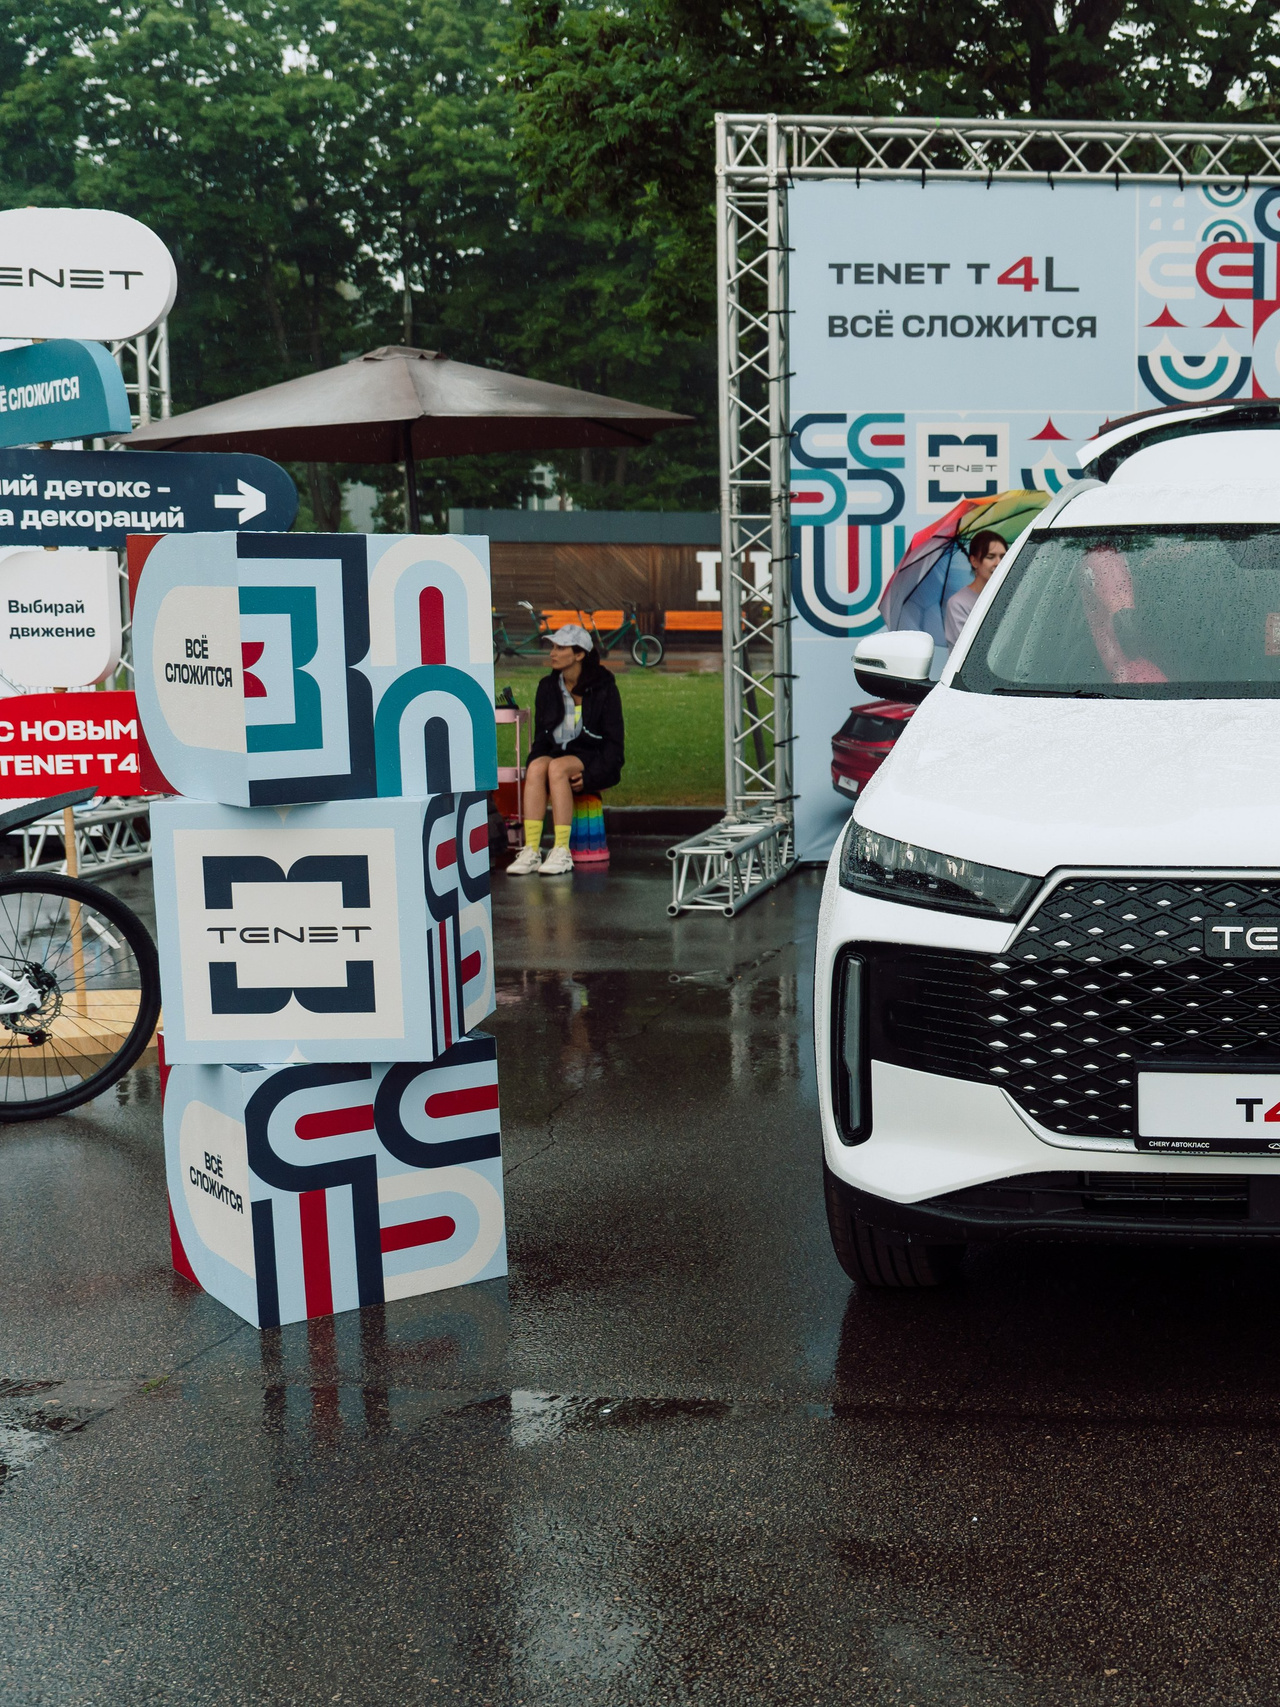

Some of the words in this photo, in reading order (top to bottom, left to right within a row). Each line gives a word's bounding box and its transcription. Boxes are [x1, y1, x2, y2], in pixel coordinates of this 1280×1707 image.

[0, 266, 144, 290] ENET
[828, 262, 951, 285] TENET
[966, 256, 1080, 293] T4L
[828, 309, 894, 338] ВСЁ
[902, 314, 1097, 340] СЛОЖИТСЯ
[8, 376, 80, 411] СЛОЖИТСЯ
[928, 464, 998, 473] TENET
[0, 474, 38, 496] ий
[44, 478, 151, 500] детокс
[20, 506, 185, 532] декораций
[8, 599, 85, 617] Выбирай
[10, 626, 96, 639] движение
[185, 634, 209, 660] ВСЁ
[165, 662, 233, 688] СЛОЖИТСЯ
[20, 719, 138, 742] НОВЫМ
[0, 753, 94, 776] TENET
[97, 752, 140, 775] T4
[206, 925, 372, 944] TENET
[1171, 1141, 1210, 1149] АВТОКЛАСС
[204, 1151, 224, 1179] ВСЁ
[189, 1165, 244, 1215] СЛОЖИТСЯ
